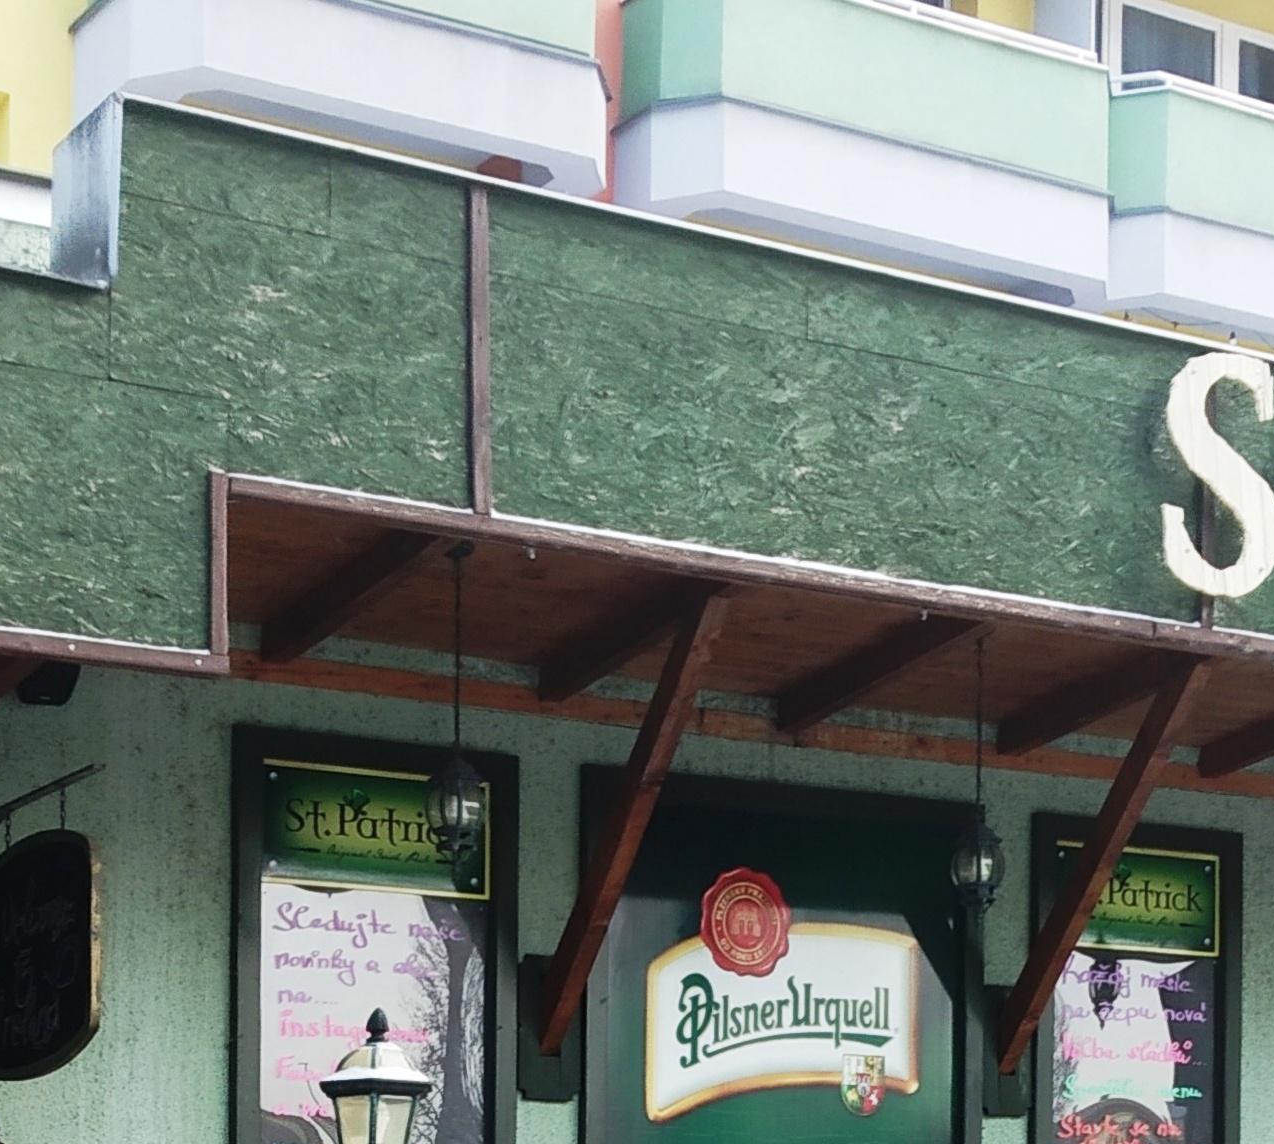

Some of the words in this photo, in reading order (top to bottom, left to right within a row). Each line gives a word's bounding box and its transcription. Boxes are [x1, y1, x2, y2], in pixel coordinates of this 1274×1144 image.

[272, 902, 396, 948] Sledujte
[275, 949, 356, 987] novinky
[676, 972, 791, 1069] Pilsner
[786, 975, 890, 1049] Urquell
